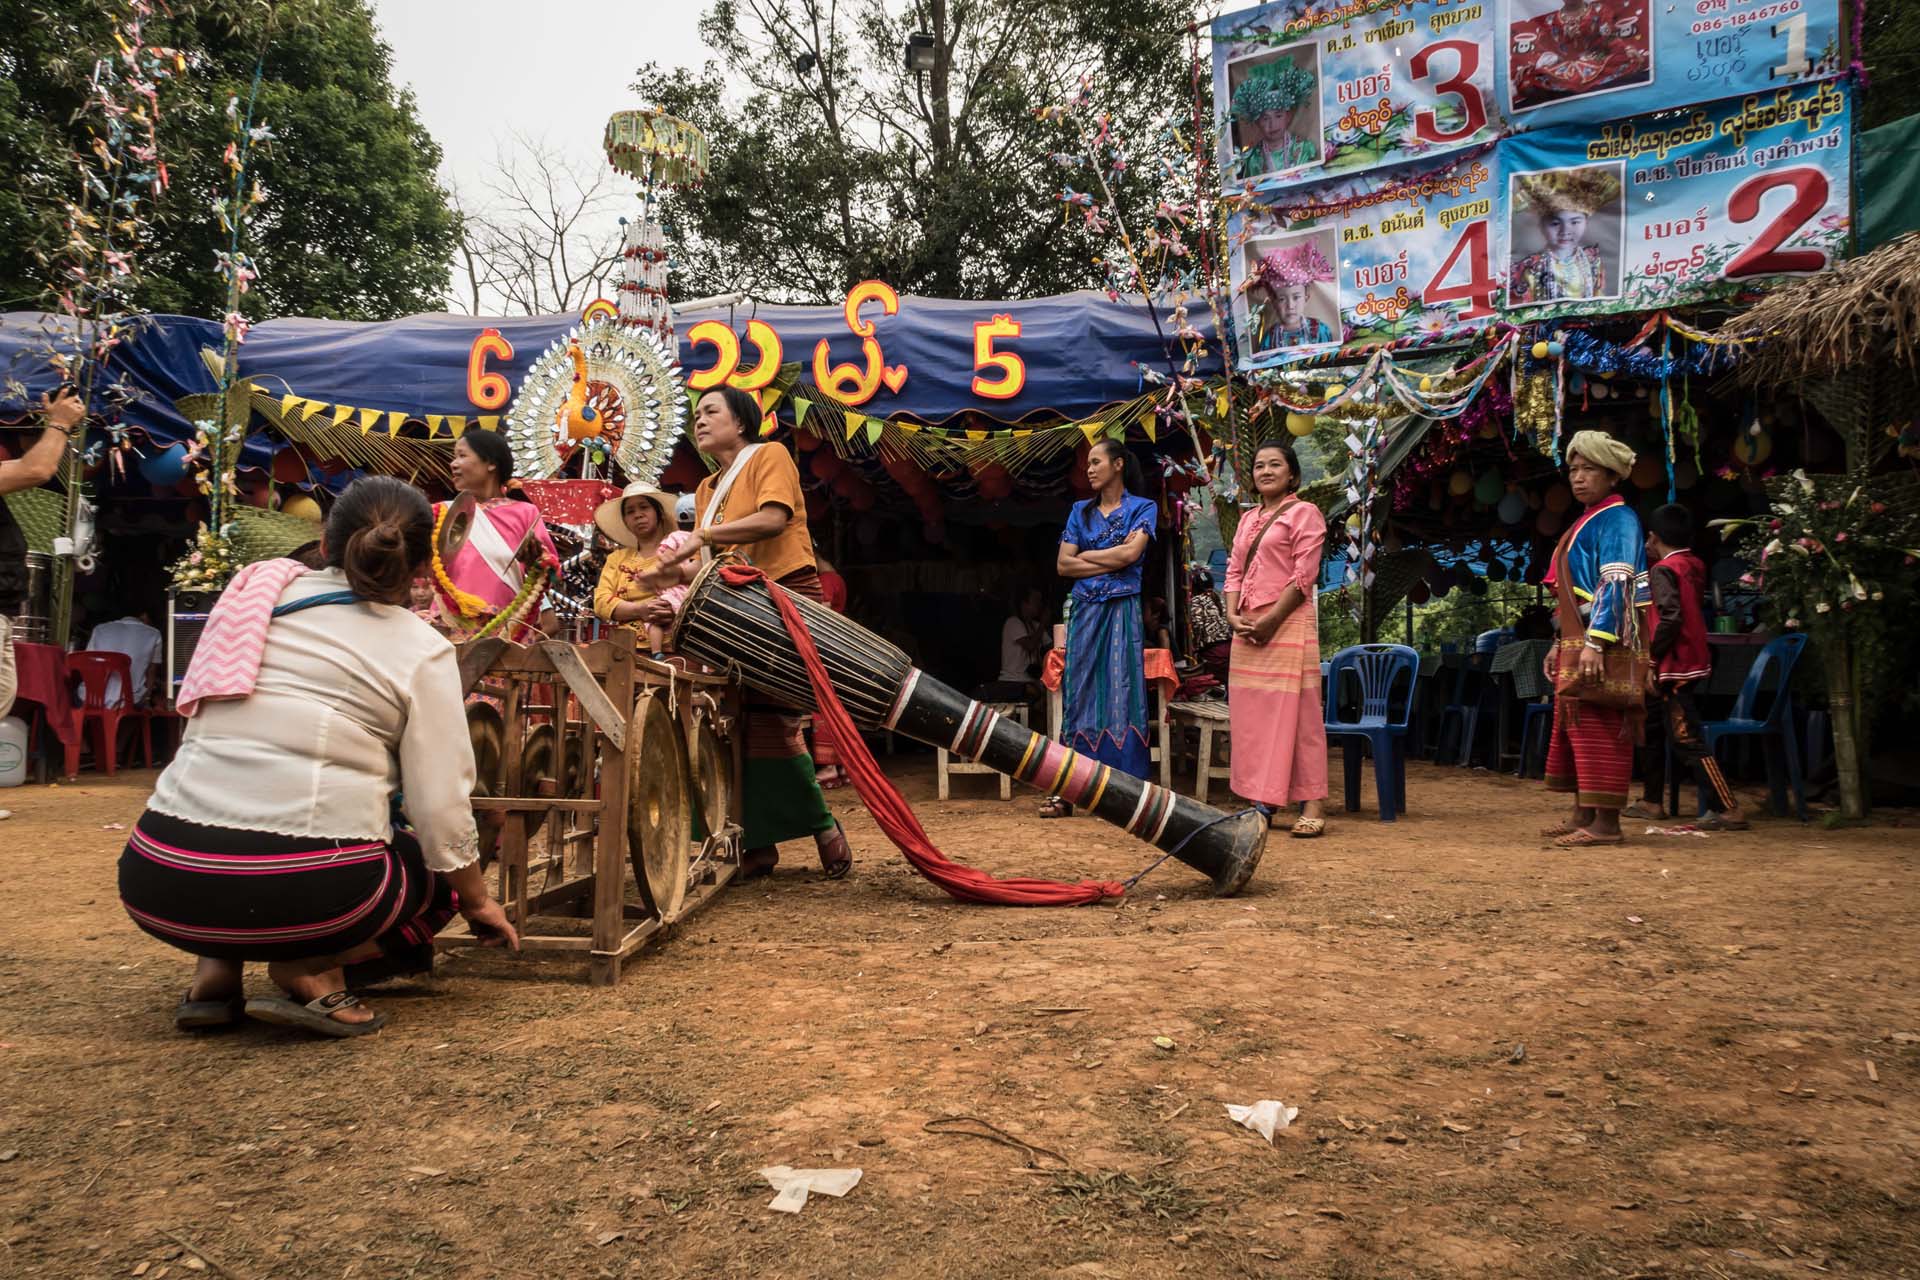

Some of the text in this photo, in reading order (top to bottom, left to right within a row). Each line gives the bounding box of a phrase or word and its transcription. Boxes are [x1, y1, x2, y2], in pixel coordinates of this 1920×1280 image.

[1692, 1, 1800, 33] 086-1846760
[1770, 13, 1812, 79] 1
[1337, 40, 1488, 143] เบอร์ 3
[1644, 165, 1828, 279] เบอร์ 2
[1354, 220, 1498, 321] เบอร์ 4
[972, 313, 1026, 400] 5
